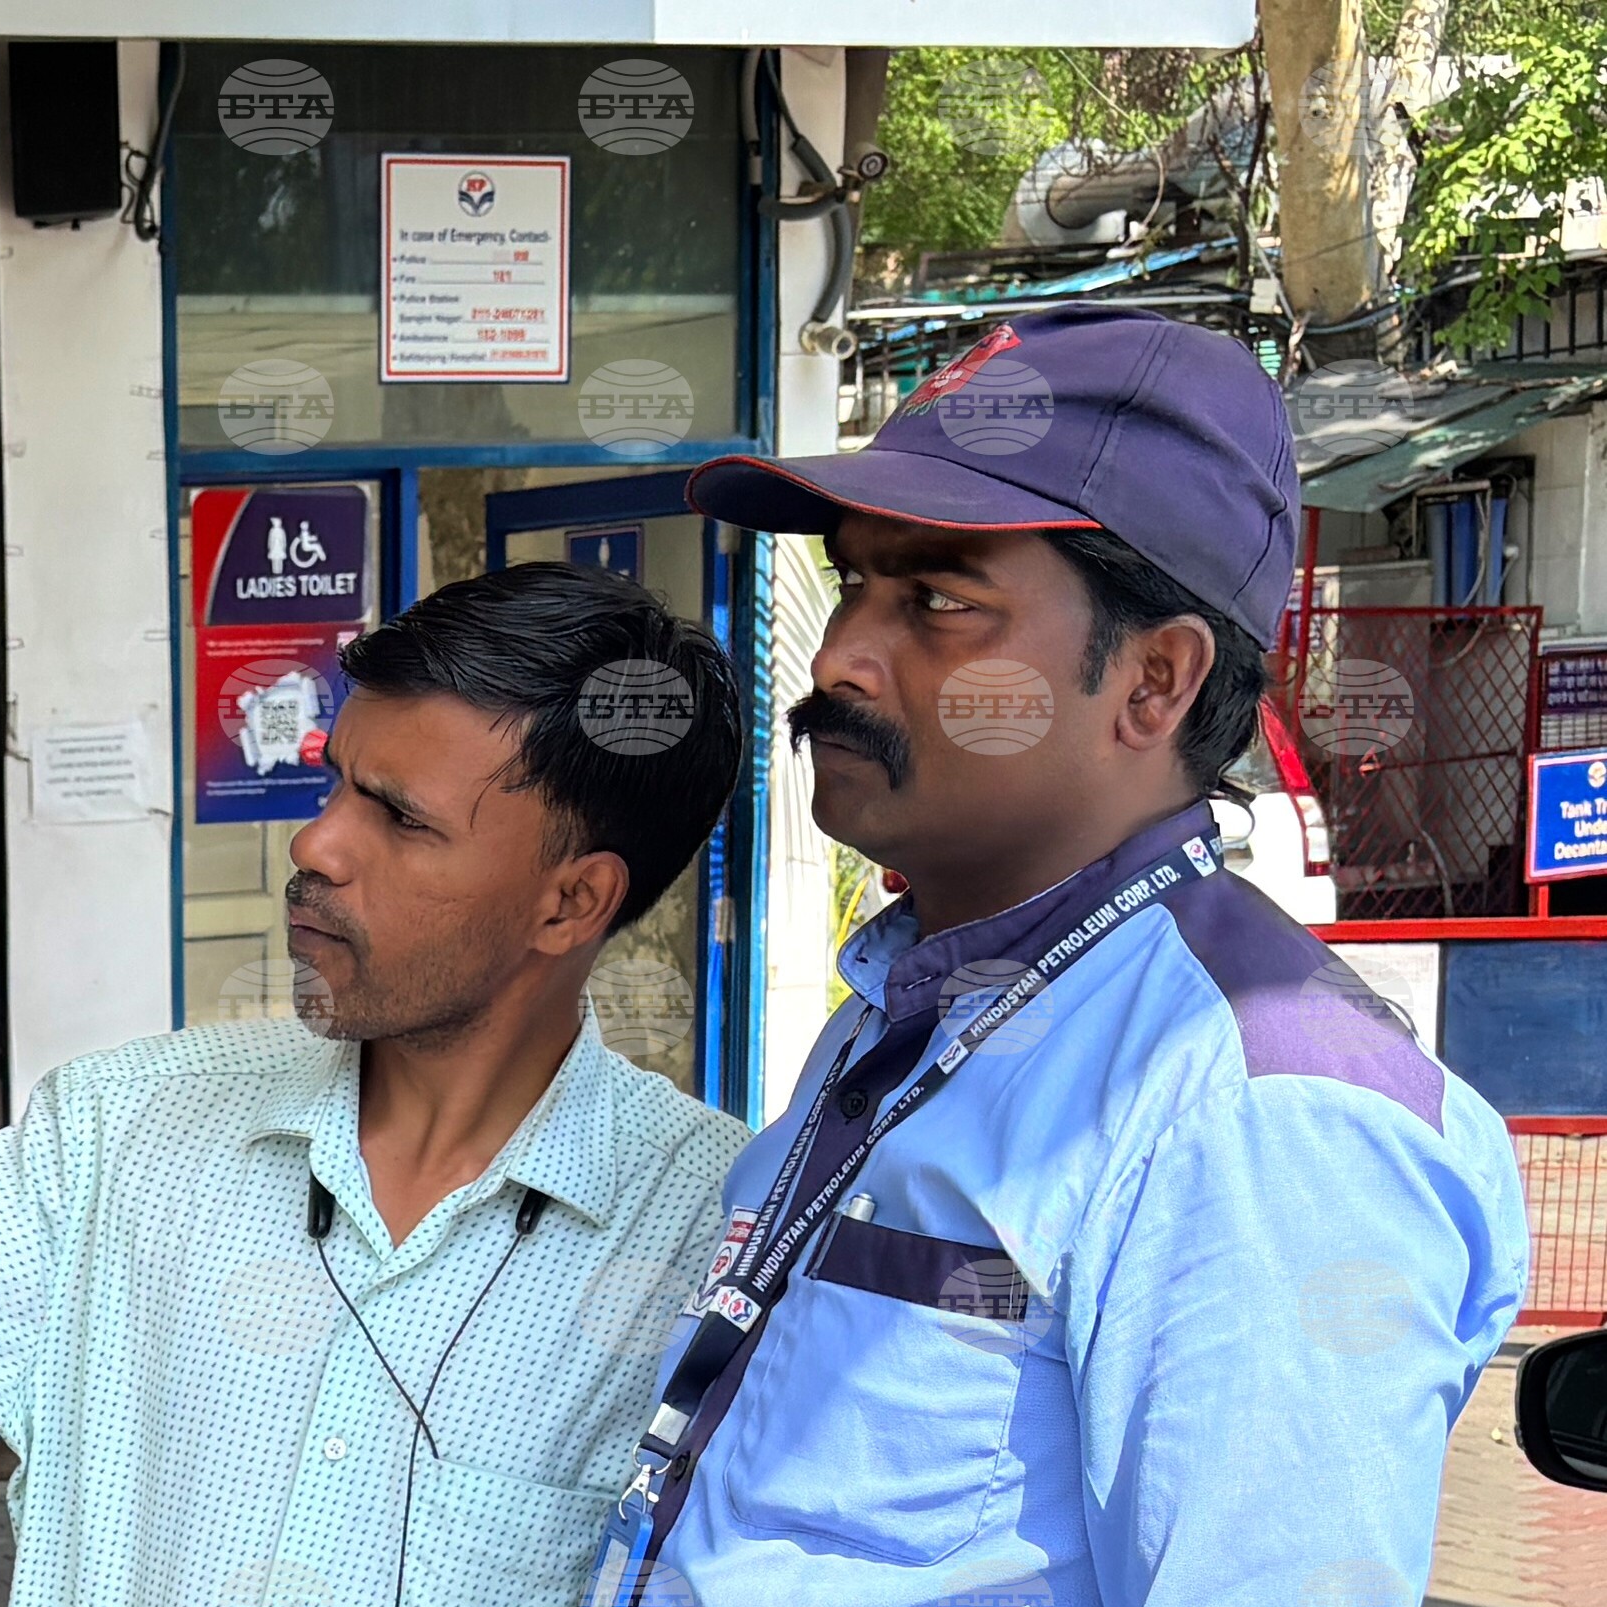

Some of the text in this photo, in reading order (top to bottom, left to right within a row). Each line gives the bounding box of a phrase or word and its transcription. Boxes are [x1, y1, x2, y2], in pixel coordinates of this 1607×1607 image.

[438, 228, 448, 241] of
[236, 573, 357, 599] LADIES TOILET
[1560, 800, 1593, 819] Tank
[969, 865, 1182, 1038] HINDUSTAN PETROLEUM CORP. LTD.
[752, 1219, 808, 1293] HINDUSTAN
[806, 1143, 867, 1221] PETROLEUM
[897, 1085, 925, 1112] LTD.
[735, 1205, 777, 1278] HINDUSTAN
